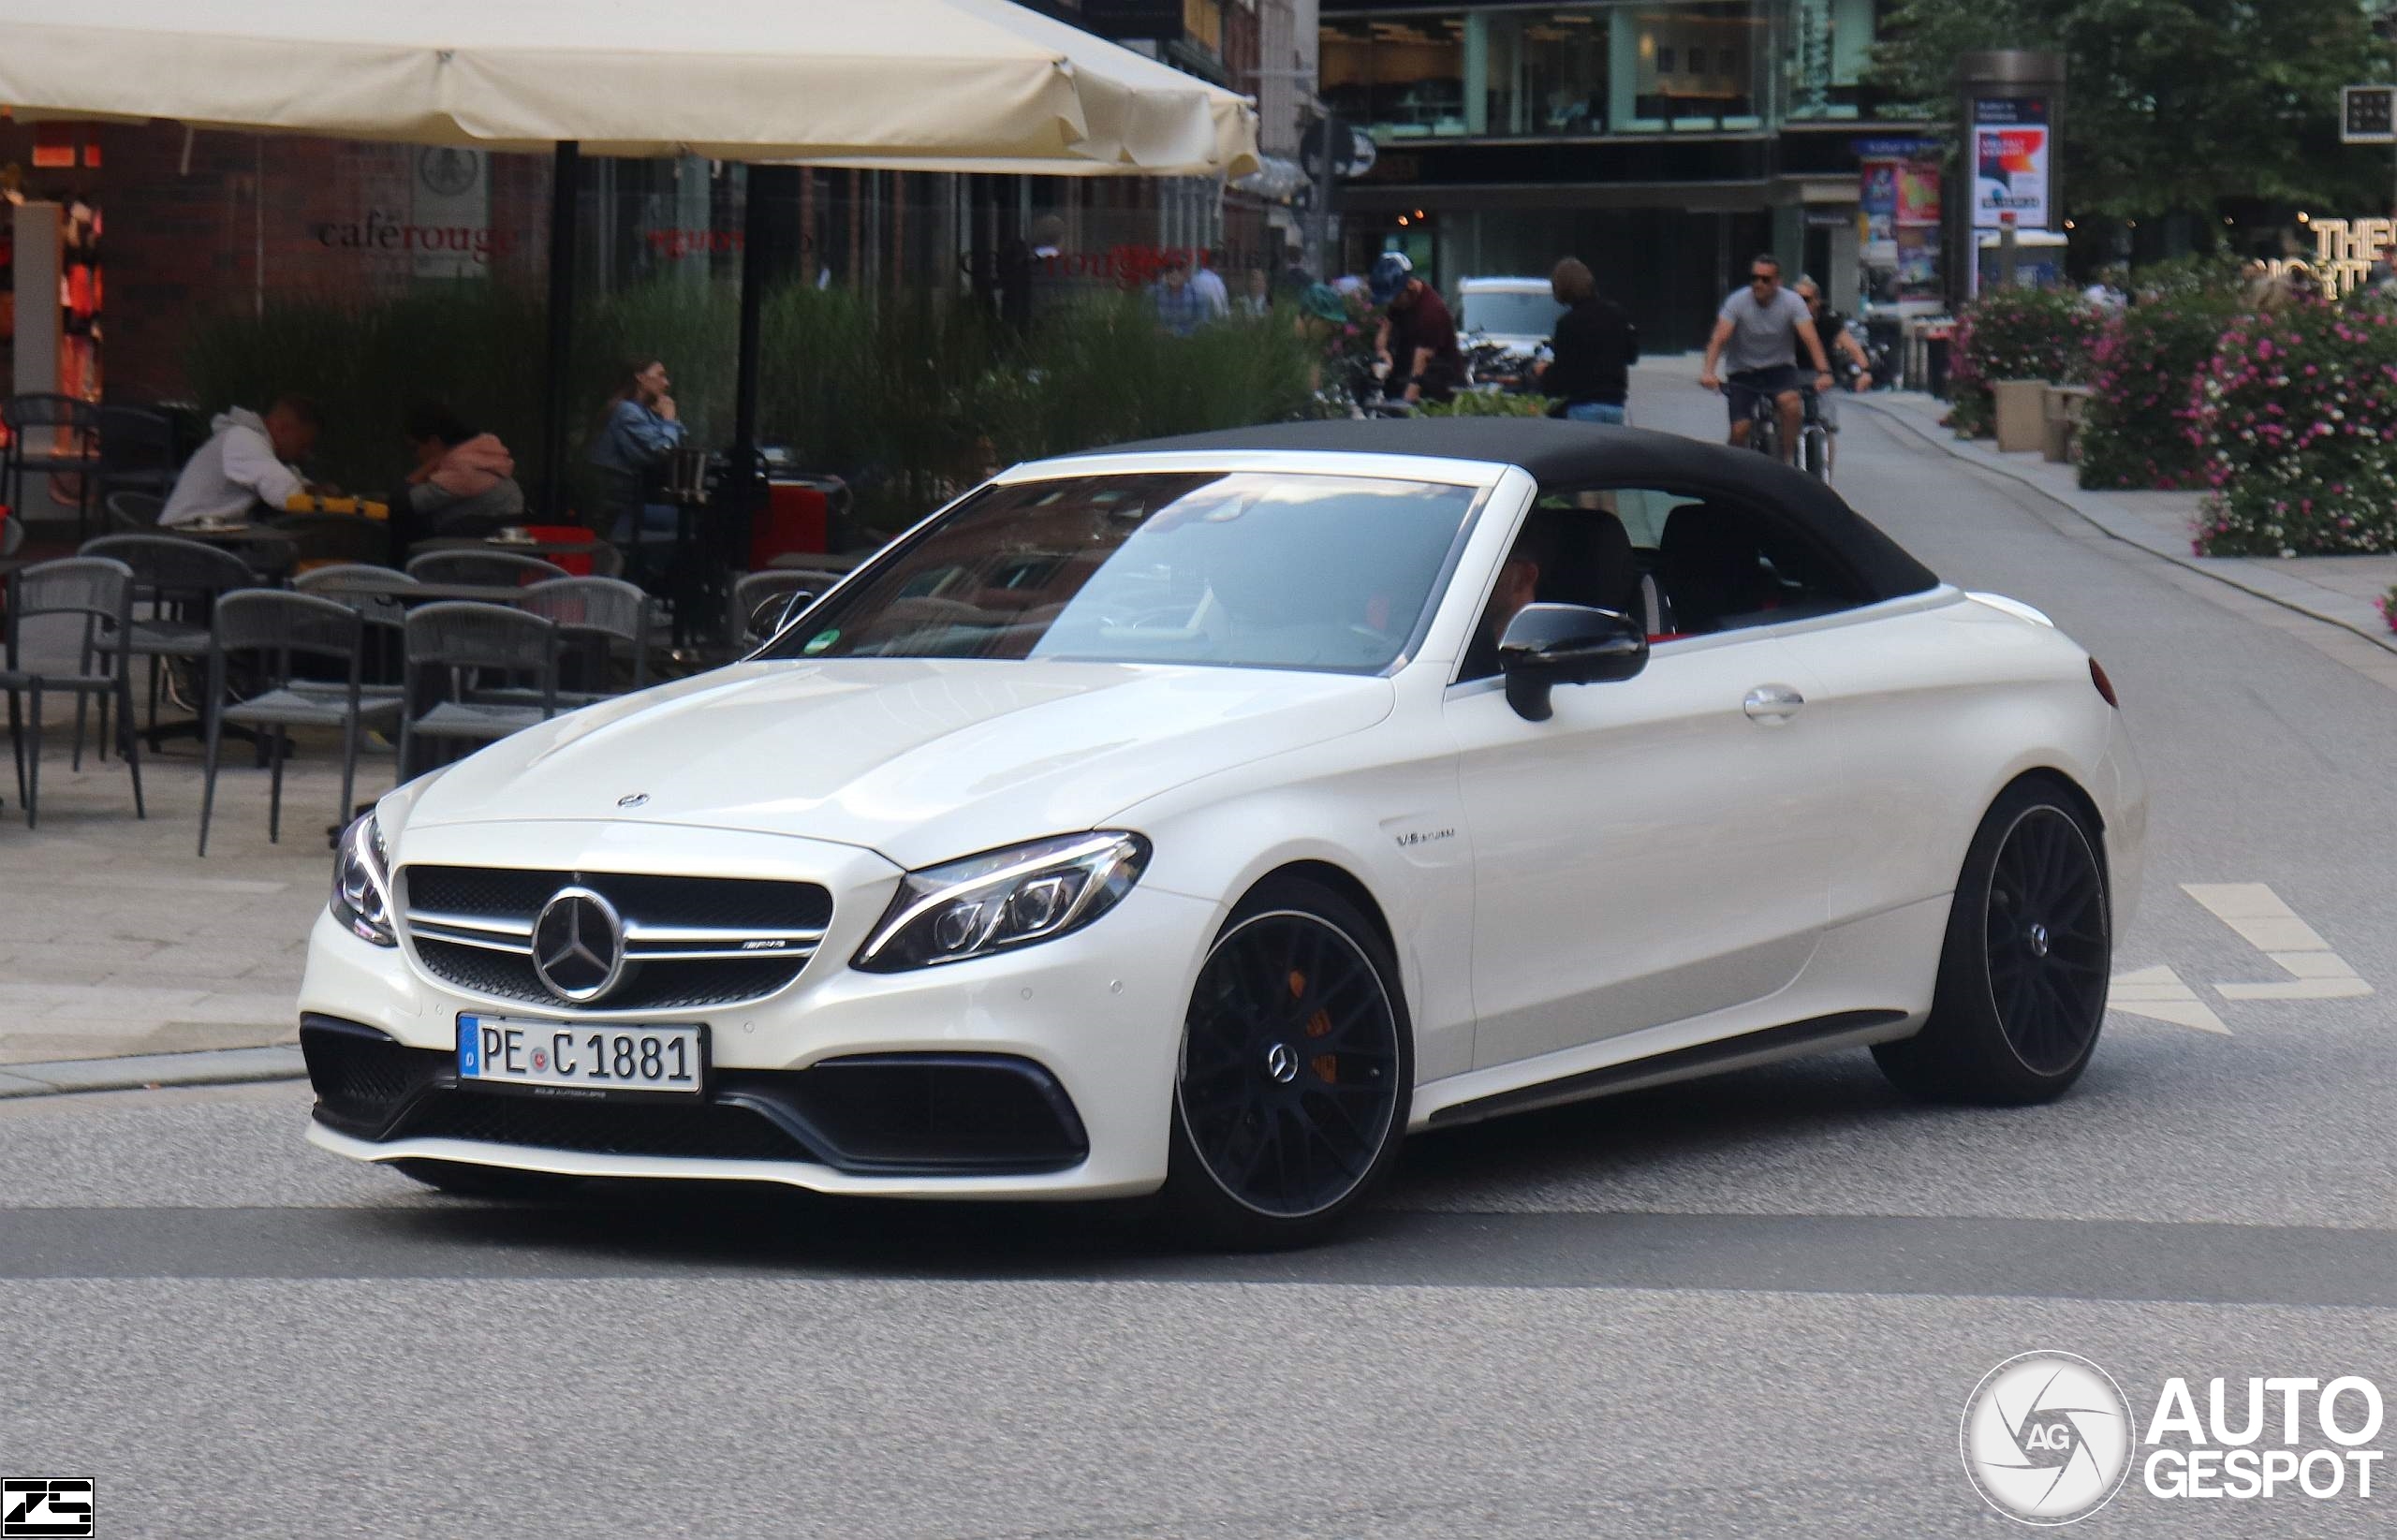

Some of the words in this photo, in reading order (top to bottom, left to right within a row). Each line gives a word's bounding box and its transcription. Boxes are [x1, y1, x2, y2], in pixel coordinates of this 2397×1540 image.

[482, 1024, 526, 1074] PE
[552, 1030, 576, 1076] C
[587, 1033, 692, 1080] 1881
